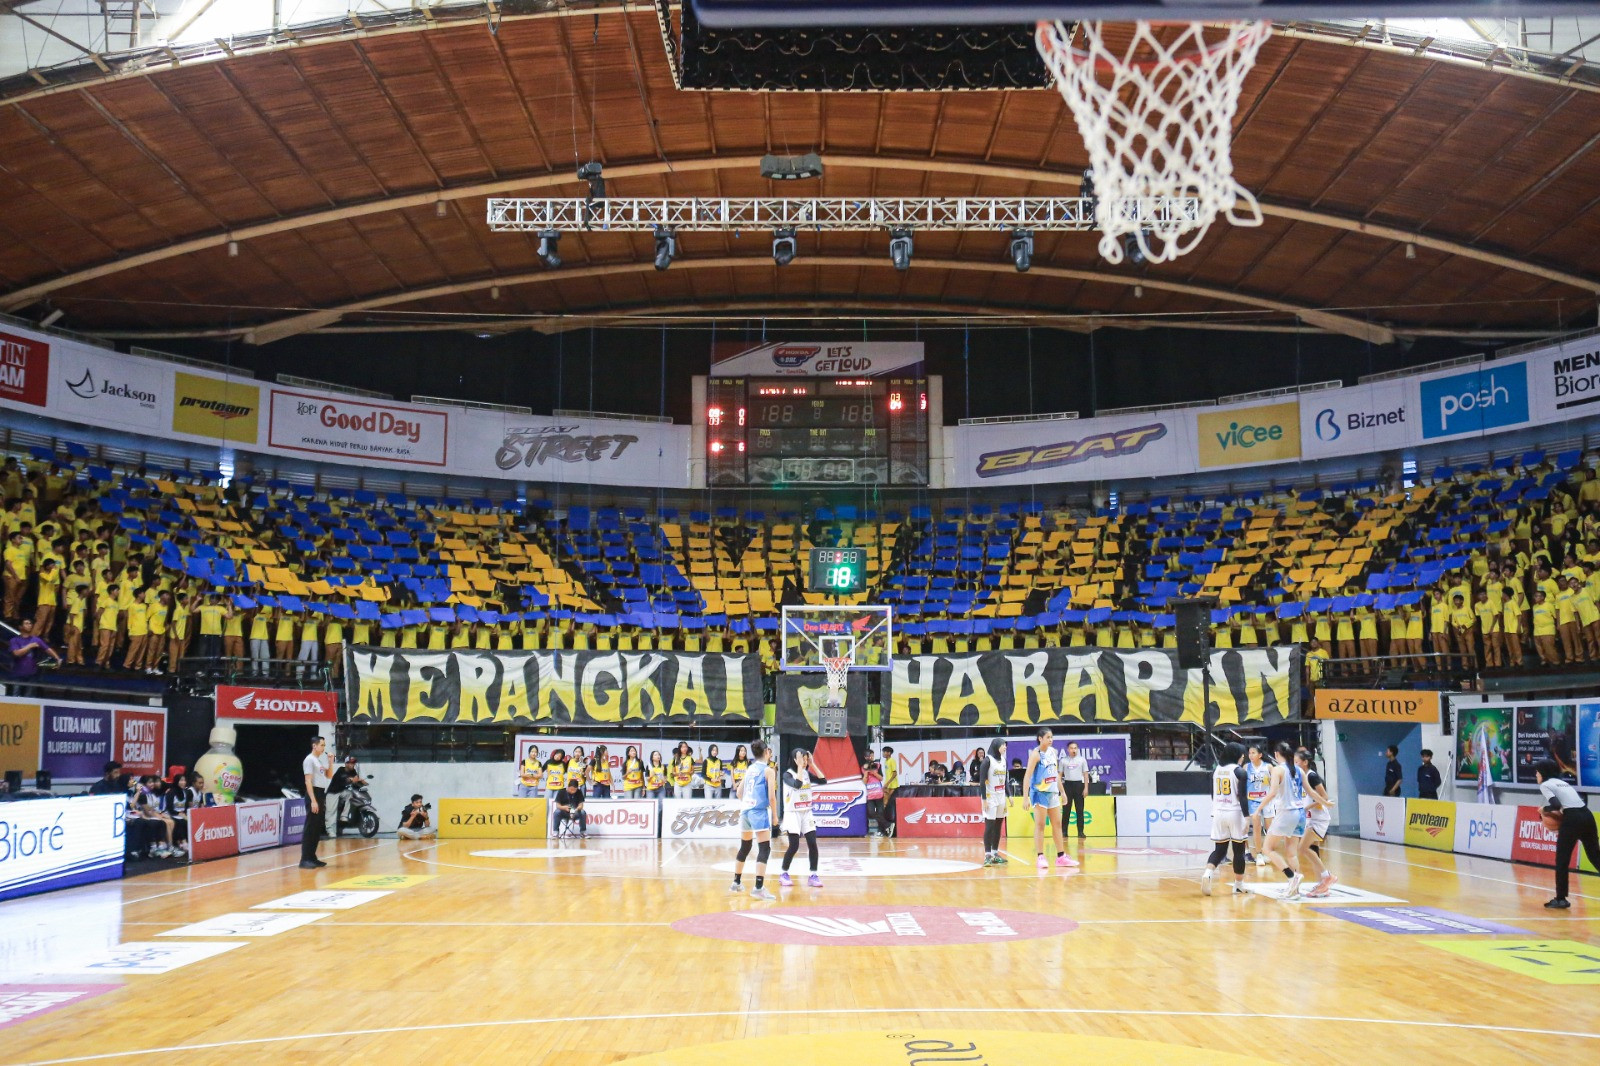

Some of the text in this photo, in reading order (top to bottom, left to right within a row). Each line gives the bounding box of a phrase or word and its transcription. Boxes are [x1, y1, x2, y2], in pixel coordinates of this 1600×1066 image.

[827, 346, 852, 358] LET'S
[815, 357, 872, 373] GET LOUD
[101, 379, 156, 403] Jackson
[179, 396, 251, 416] proteam
[1440, 373, 1509, 431] posh
[320, 405, 420, 443] Good Day
[1347, 406, 1405, 431] Biznet
[301, 437, 328, 446] KARENA
[495, 434, 639, 470] STREET
[978, 425, 1164, 474] BEAT
[351, 650, 750, 723] MERANGKAI
[889, 645, 1294, 726] HARAPAN
[254, 698, 323, 713] HONDA
[53, 716, 102, 733] ULTRA MILK
[123, 719, 145, 742] HOT
[123, 742, 155, 762] CREAM
[1216, 777, 1232, 795] 18
[264, 813, 277, 835] Day
[617, 809, 649, 829] Day
[671, 809, 741, 836] STREE
[926, 813, 985, 824] HOND
[1146, 799, 1198, 833] posh
[1409, 812, 1449, 828] proteam
[203, 825, 235, 841] HONDA
[1468, 809, 1498, 849] posh
[1519, 820, 1536, 840] HOT
